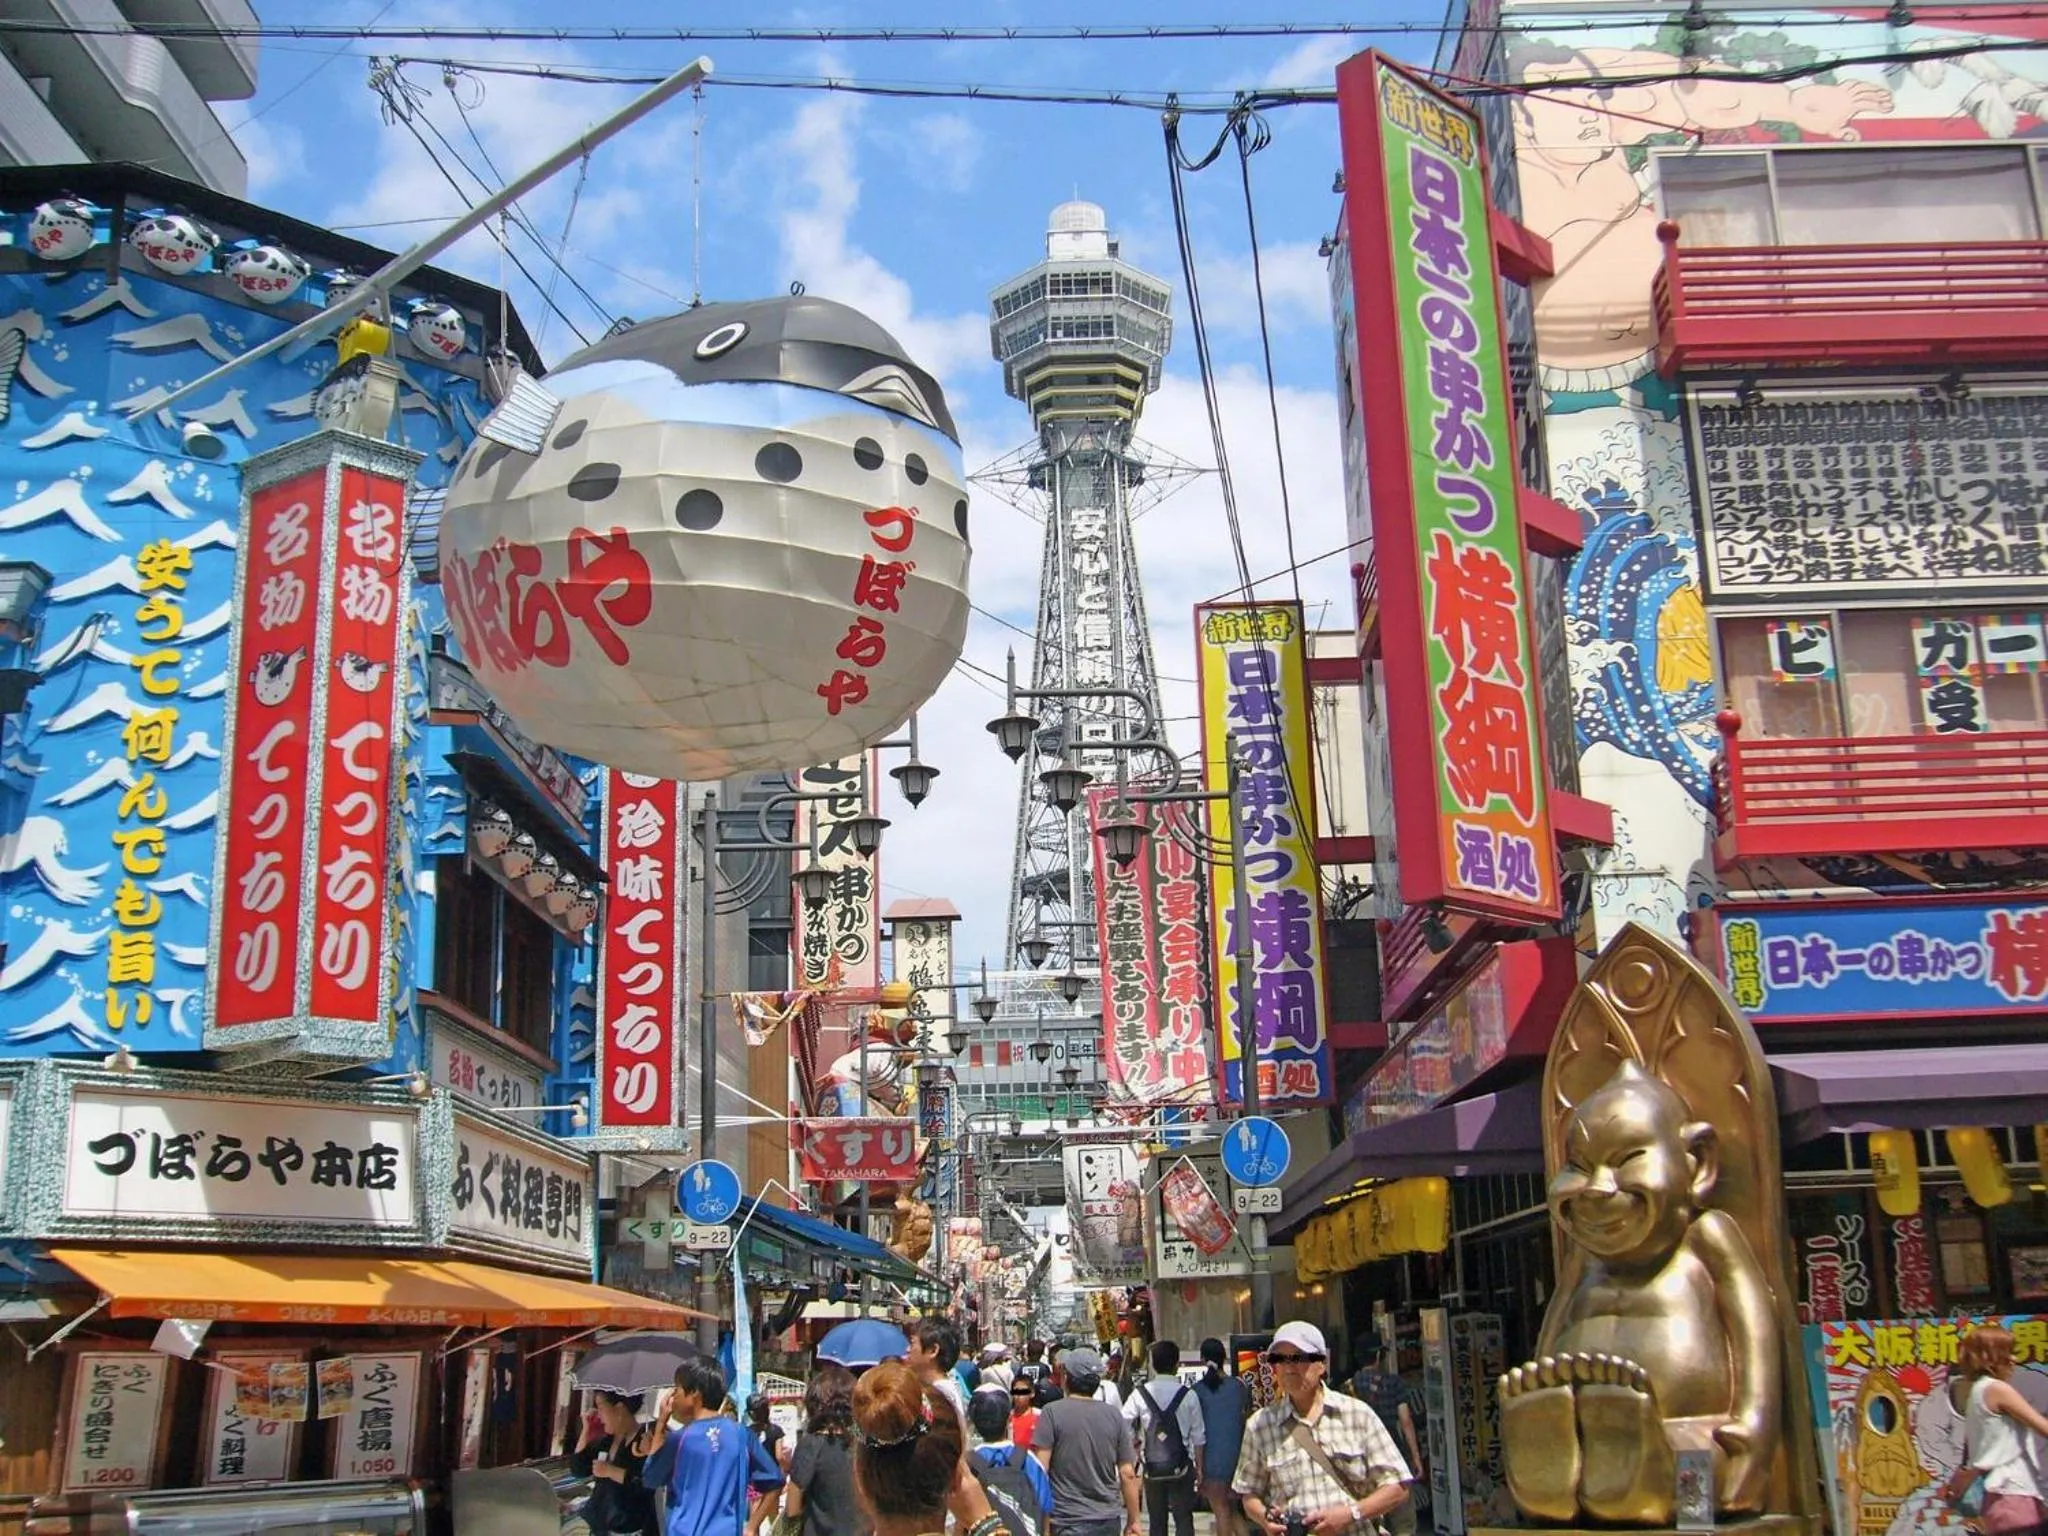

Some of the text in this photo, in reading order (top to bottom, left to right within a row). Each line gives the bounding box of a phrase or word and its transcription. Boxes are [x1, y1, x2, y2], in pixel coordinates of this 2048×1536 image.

[1383, 72, 1475, 167] 新世界
[1408, 149, 1495, 533] 日本一の串かつ
[1960, 478, 2012, 574] つくね
[817, 504, 920, 717] づぼらや
[1205, 609, 1292, 643] 新世界
[1430, 535, 1536, 825] 横綱
[234, 502, 311, 993] 名物 てっちり
[320, 499, 398, 991] 名物 てっちり
[1457, 821, 1540, 898] 酒処
[611, 797, 666, 1114] 珍味てっちり
[831, 864, 872, 963] 串かつ
[1225, 888, 1318, 1053] 横綱
[1727, 922, 1762, 1007] 新世界
[1766, 935, 1983, 985] 日本一の串かつ
[88, 1127, 399, 1194] づぼらや本店
[451, 1139, 582, 1244] ふぐ料理専門
[804, 1128, 912, 1166] くすり
[822, 1167, 889, 1179] TAKAHARA
[628, 1221, 685, 1239] くすり
[122, 1363, 152, 1394] ふぐ
[1831, 1321, 2048, 1368] 大阪新界
[357, 1362, 398, 1452] ふぐ唐揚
